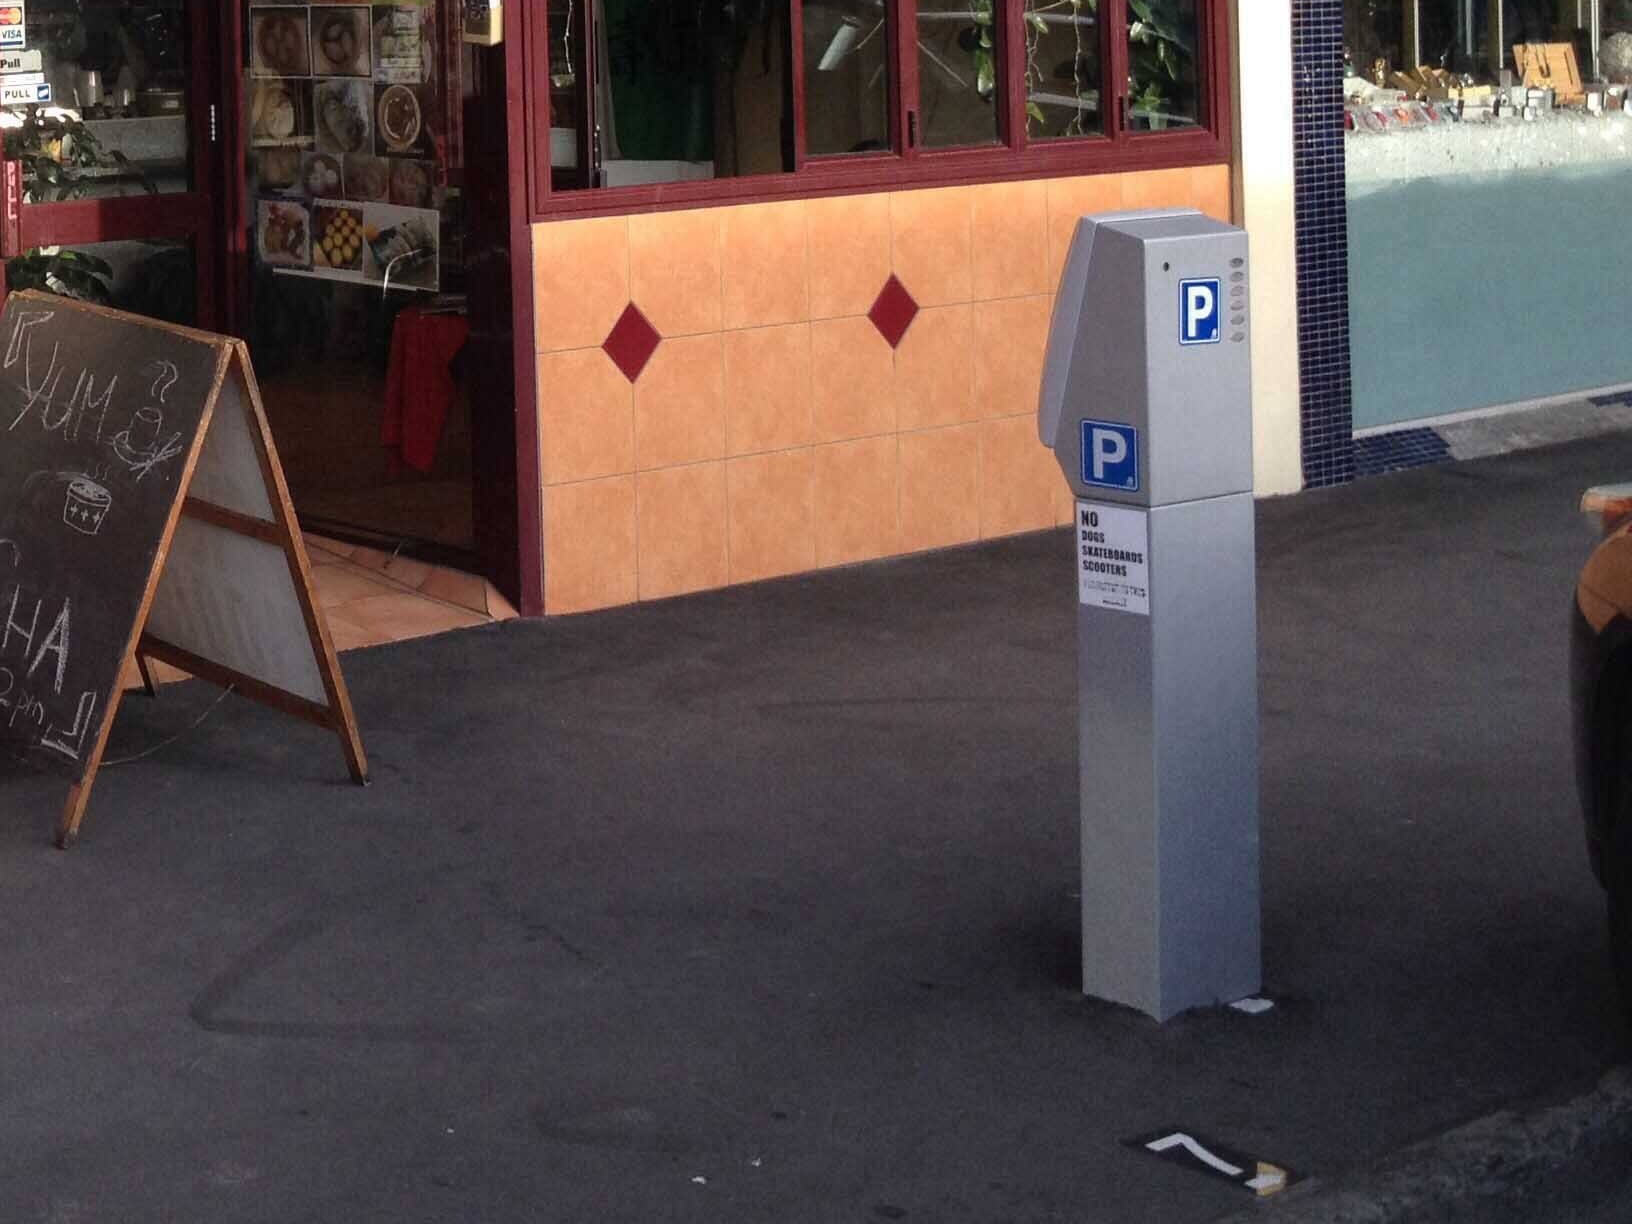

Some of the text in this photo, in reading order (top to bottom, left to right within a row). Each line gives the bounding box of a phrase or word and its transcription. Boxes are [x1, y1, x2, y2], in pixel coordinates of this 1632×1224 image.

[2, 30, 22, 39] VISA
[0, 59, 21, 69] Pull
[5, 89, 31, 99] PULL
[8, 161, 18, 220] PULL
[1188, 286, 1213, 337] P
[8, 333, 117, 441] YUM
[1093, 428, 1127, 479] P
[1081, 510, 1099, 527] NO
[1082, 530, 1105, 543] DOGS
[1082, 545, 1143, 564] SKATEBOARDS
[1082, 560, 1127, 576] SCOOTERS
